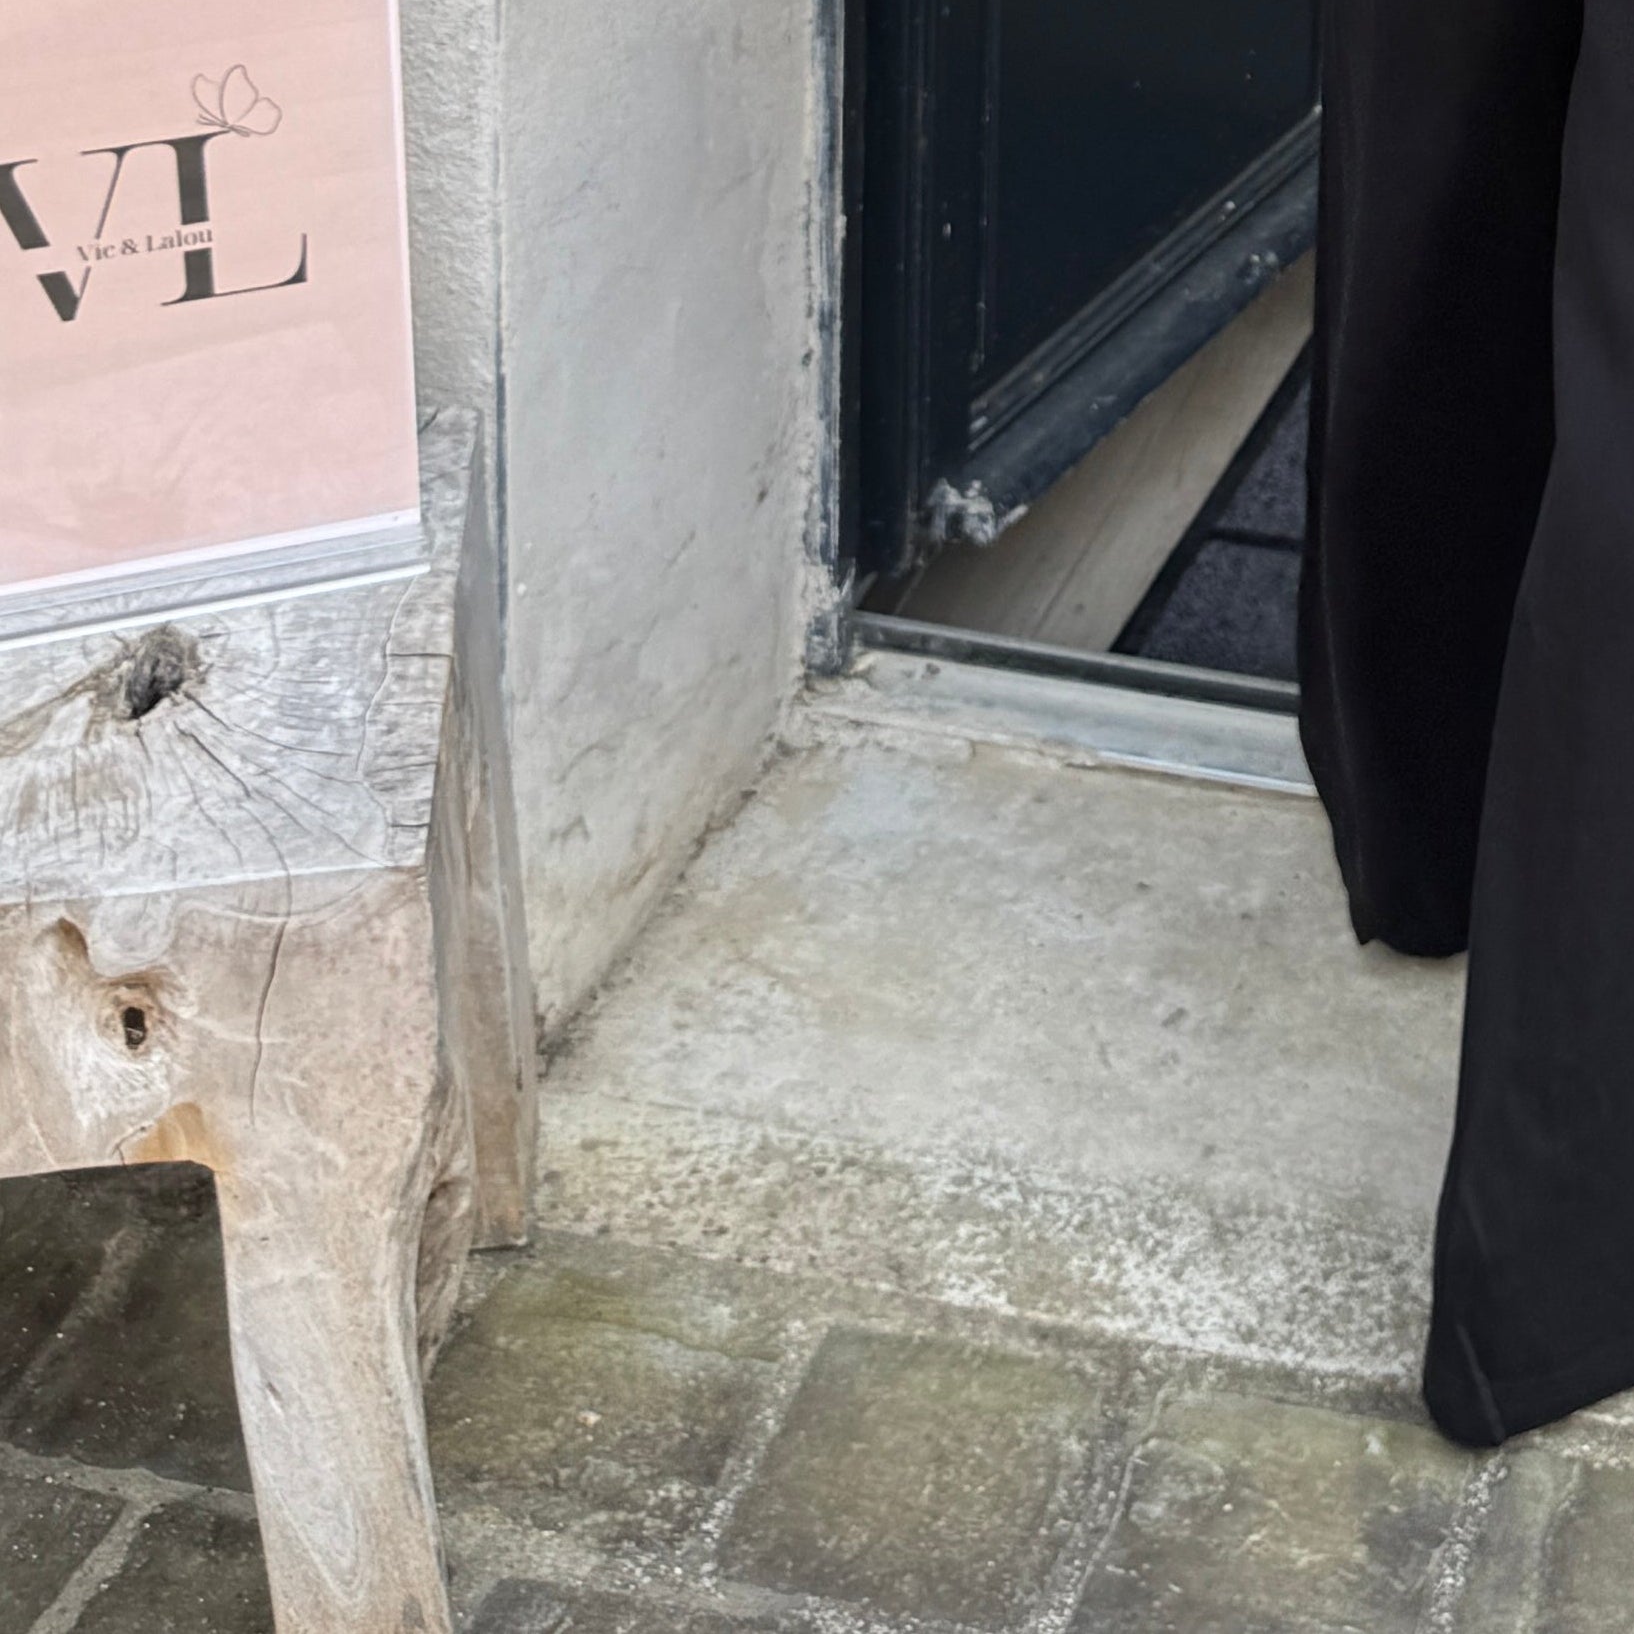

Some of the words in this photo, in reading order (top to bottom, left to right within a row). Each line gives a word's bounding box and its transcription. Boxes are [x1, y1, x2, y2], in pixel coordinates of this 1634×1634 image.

[76, 243, 116, 261] Vic
[120, 238, 139, 255] &
[146, 229, 213, 252] Lalou
